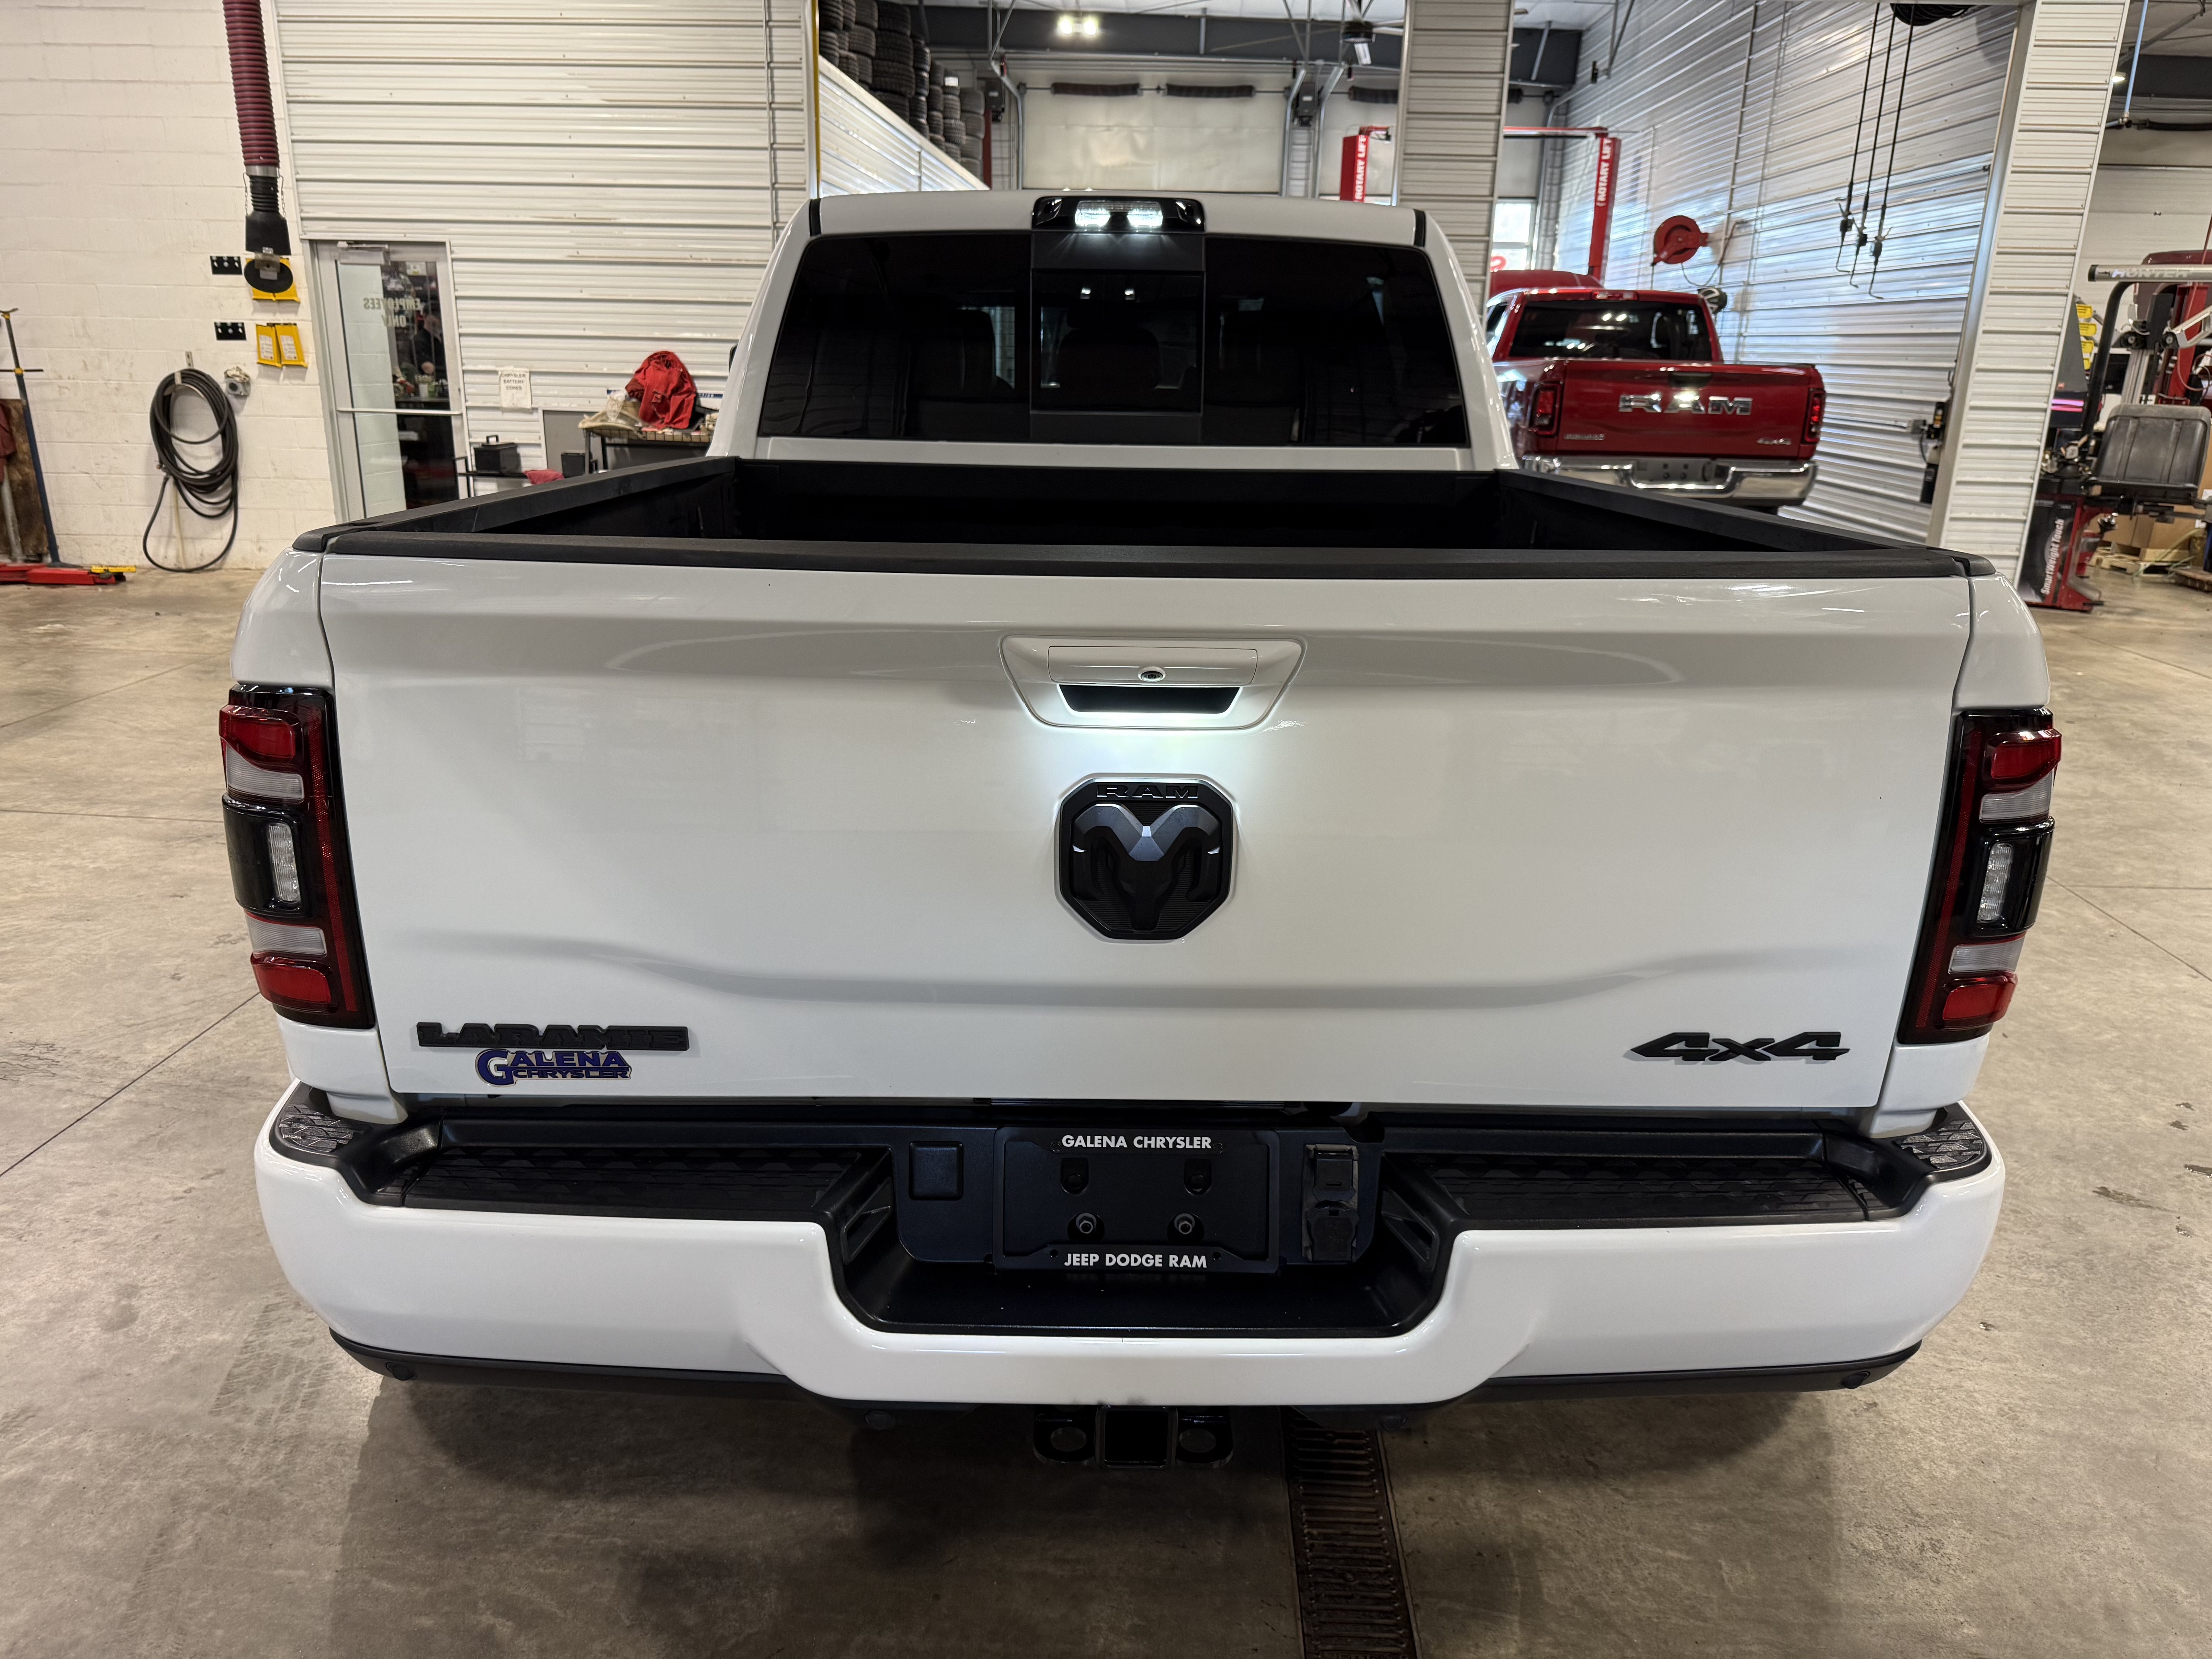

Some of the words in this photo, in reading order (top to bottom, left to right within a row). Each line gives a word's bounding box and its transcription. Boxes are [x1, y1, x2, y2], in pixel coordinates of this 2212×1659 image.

[1358, 135, 1367, 158] LIFT
[1601, 137, 1612, 160] LIFT
[1355, 159, 1365, 200] ROTARY
[1597, 161, 1610, 202] ROTARY
[2112, 269, 2188, 278] HUNTER
[1619, 393, 1753, 415] RAM
[2040, 542, 2060, 595] SmartWeight
[2051, 518, 2064, 543] Touch
[1097, 785, 1198, 799] RAM
[417, 1022, 690, 1051] LARAMIE
[476, 1048, 628, 1086] GALENA
[513, 1069, 629, 1079] CHRYSLER
[1062, 1135, 1128, 1148] GALENA
[1133, 1136, 1212, 1149] CHRYSLER
[1064, 1254, 1099, 1266] JEEP
[1106, 1253, 1163, 1267] DODGE
[1169, 1255, 1207, 1268] RAM
